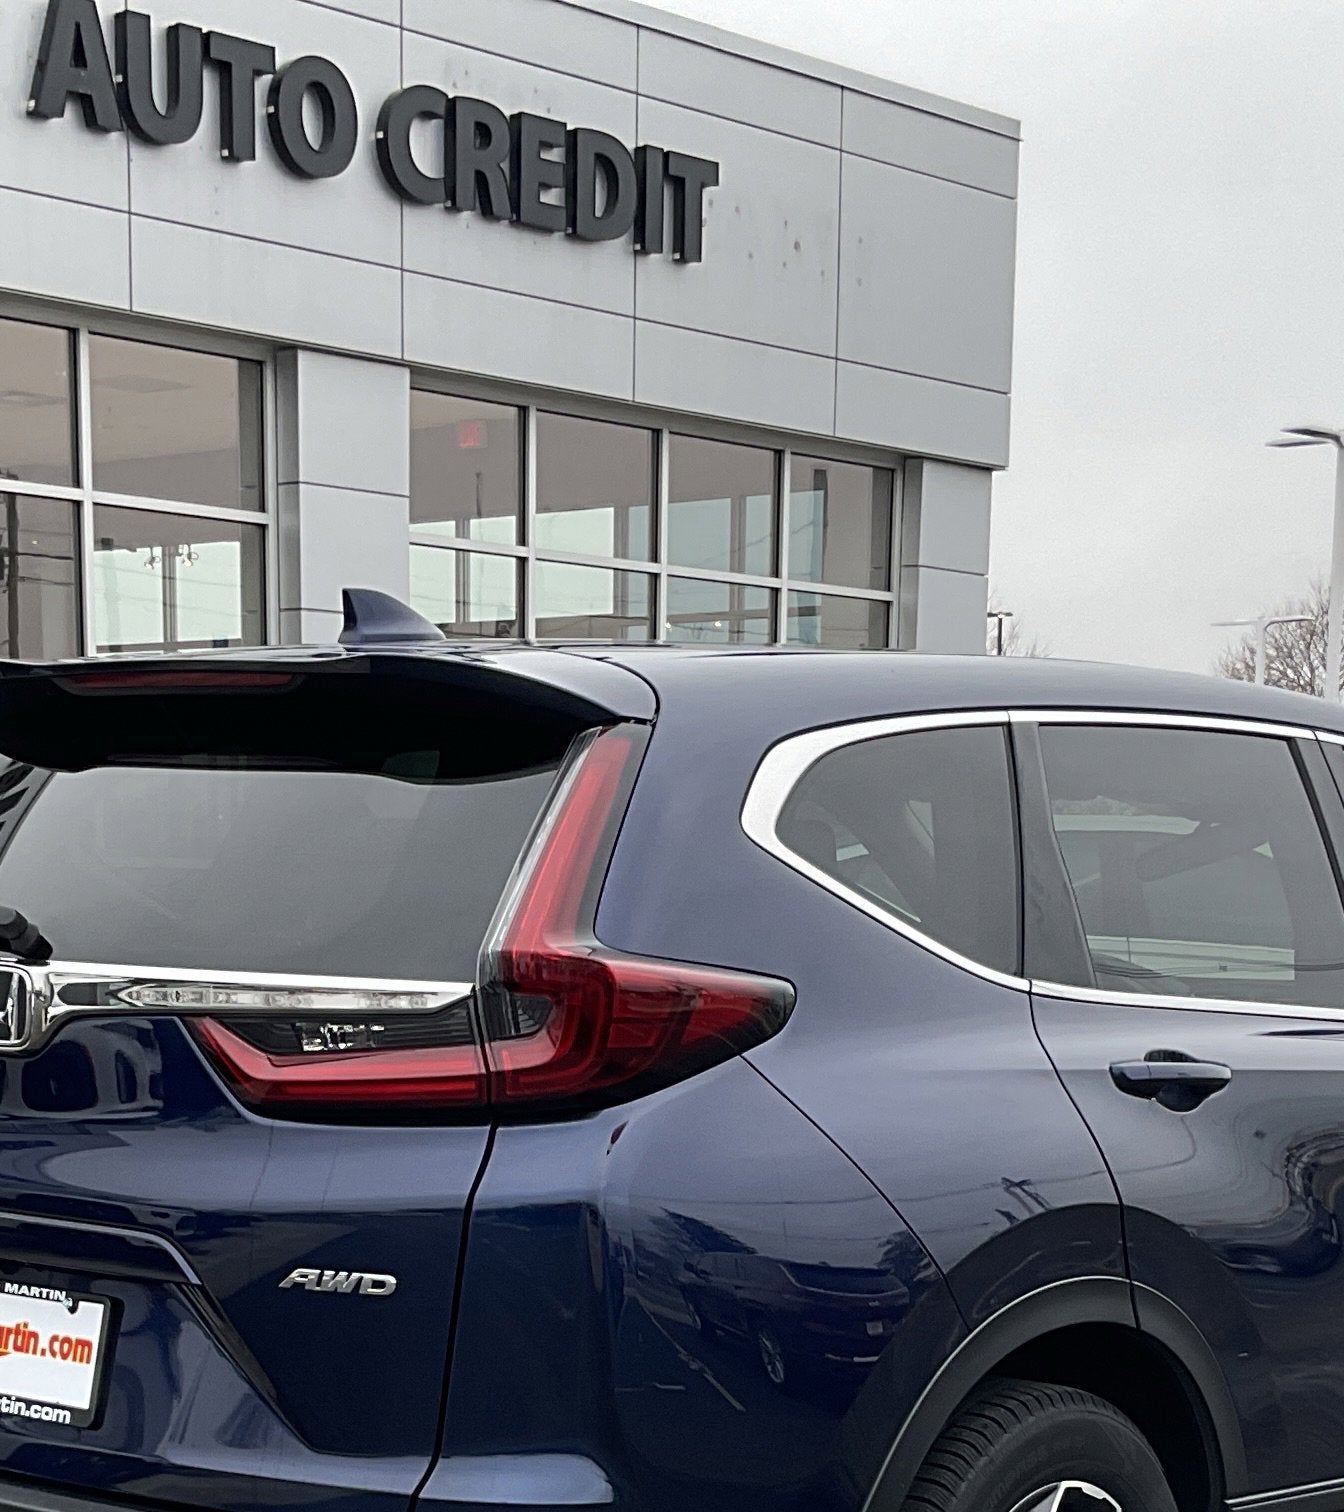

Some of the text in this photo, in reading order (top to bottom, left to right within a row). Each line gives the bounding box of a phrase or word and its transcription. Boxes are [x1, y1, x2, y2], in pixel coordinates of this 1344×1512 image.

[26, 0, 719, 263] AUTO CREDIT
[4, 1282, 67, 1302] MARTIN
[278, 1267, 397, 1296] AWD
